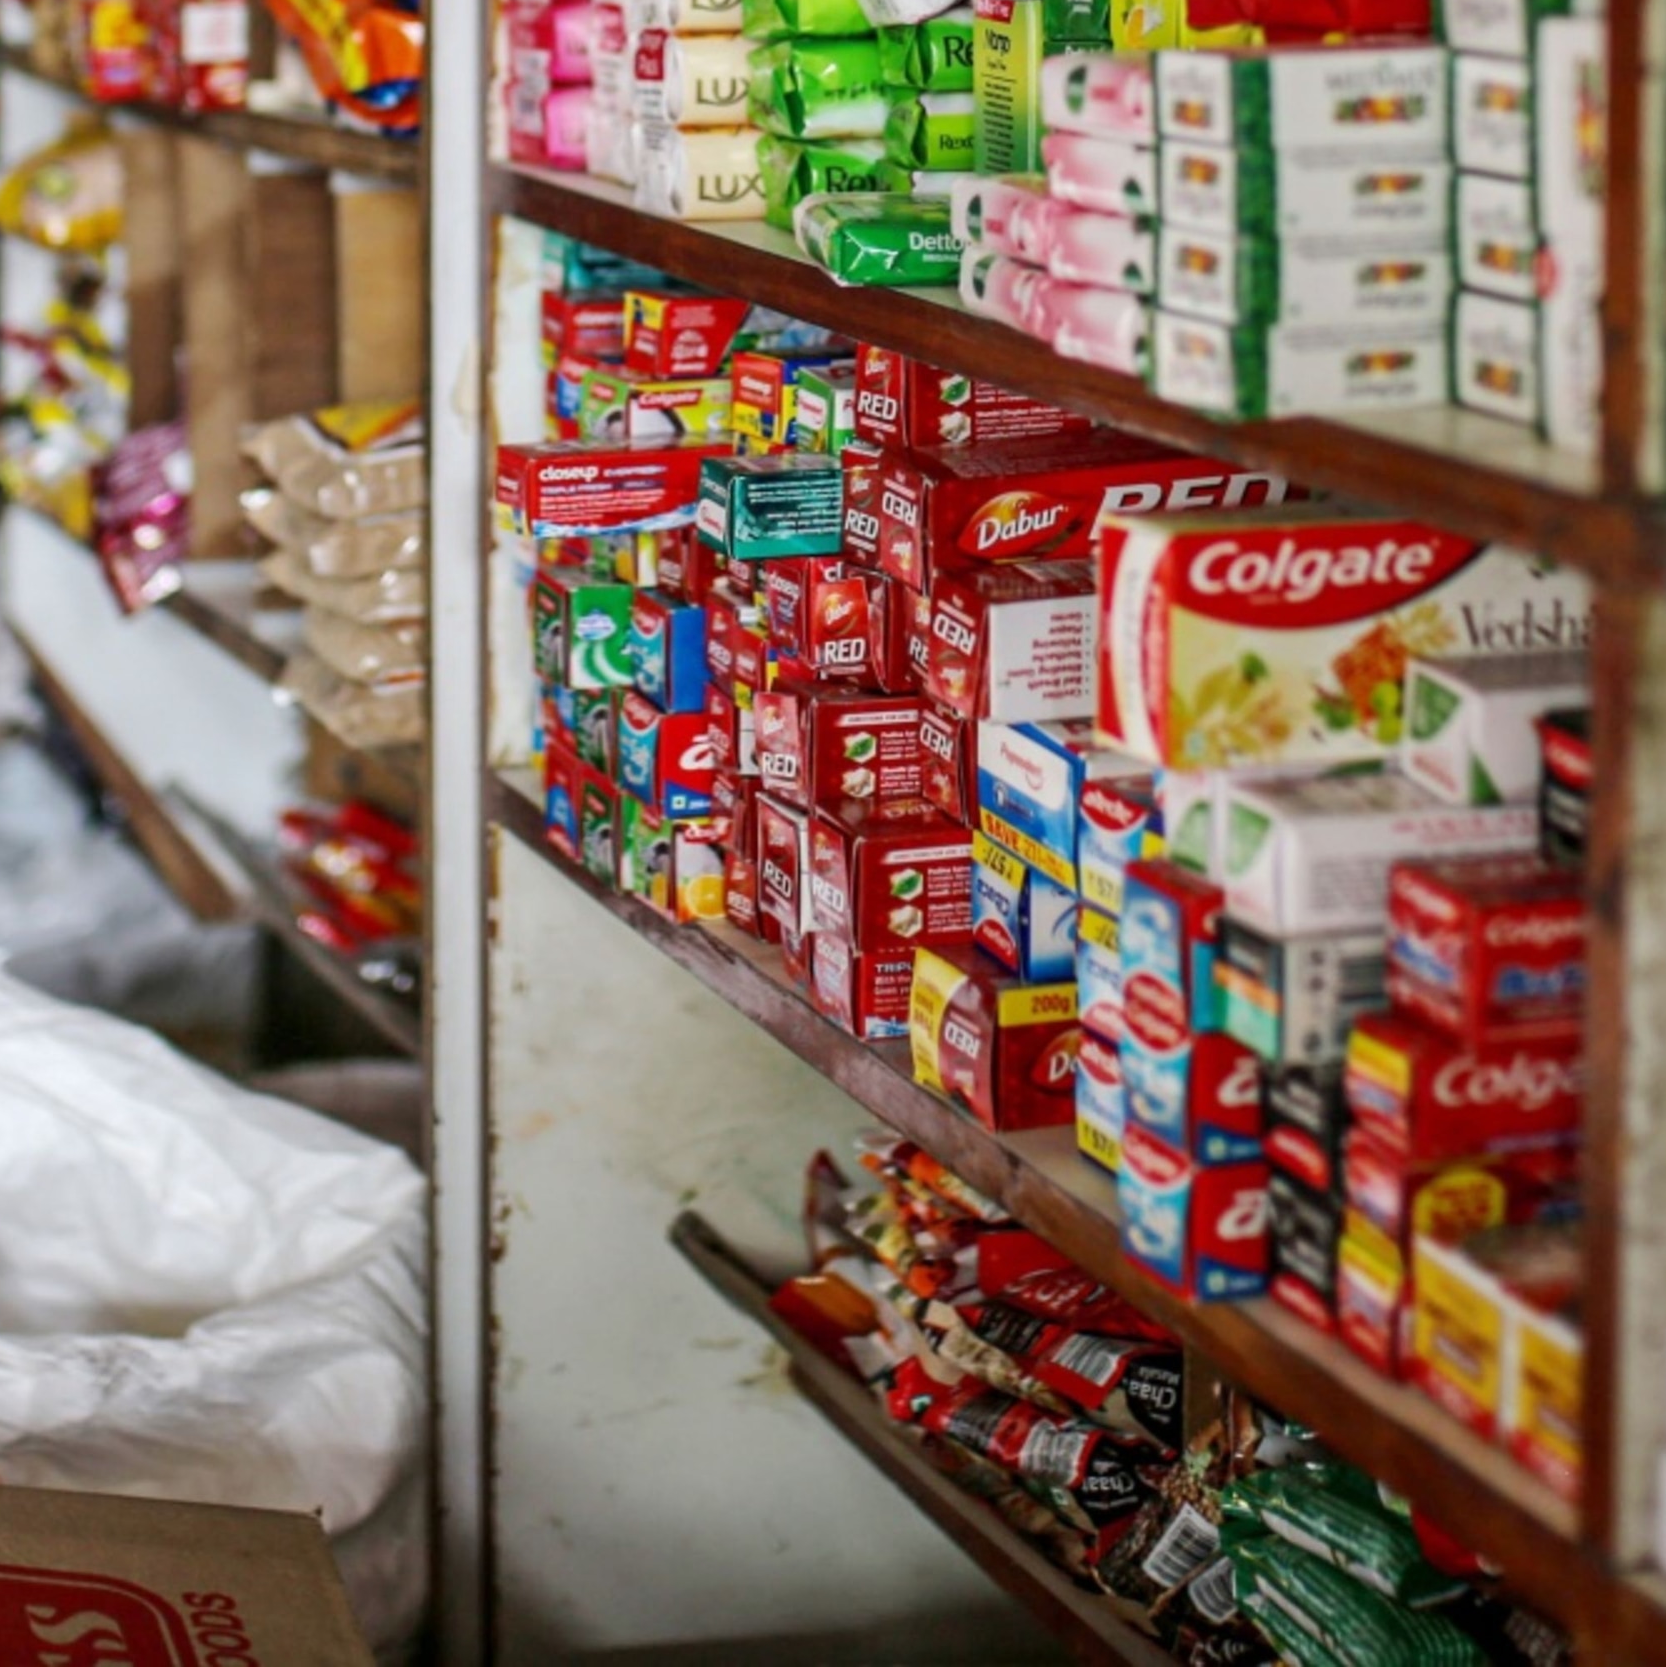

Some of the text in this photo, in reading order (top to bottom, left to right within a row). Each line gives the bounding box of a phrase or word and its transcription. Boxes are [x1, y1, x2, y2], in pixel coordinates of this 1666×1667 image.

[698, 173, 766, 203] LUX
[857, 391, 897, 421] RED
[539, 465, 599, 482] closeup
[844, 508, 879, 538] RED
[882, 491, 919, 528] RED
[977, 503, 1062, 550] Dabur
[1188, 539, 1434, 602] Colgate
[934, 613, 976, 656] RED
[824, 638, 866, 663] RED
[919, 722, 954, 762] RED
[762, 751, 797, 778] RED
[763, 860, 792, 898] RED
[1031, 994, 1070, 1014] 200g
[943, 1020, 981, 1060] RED
[1126, 1380, 1178, 1411] Chaa
